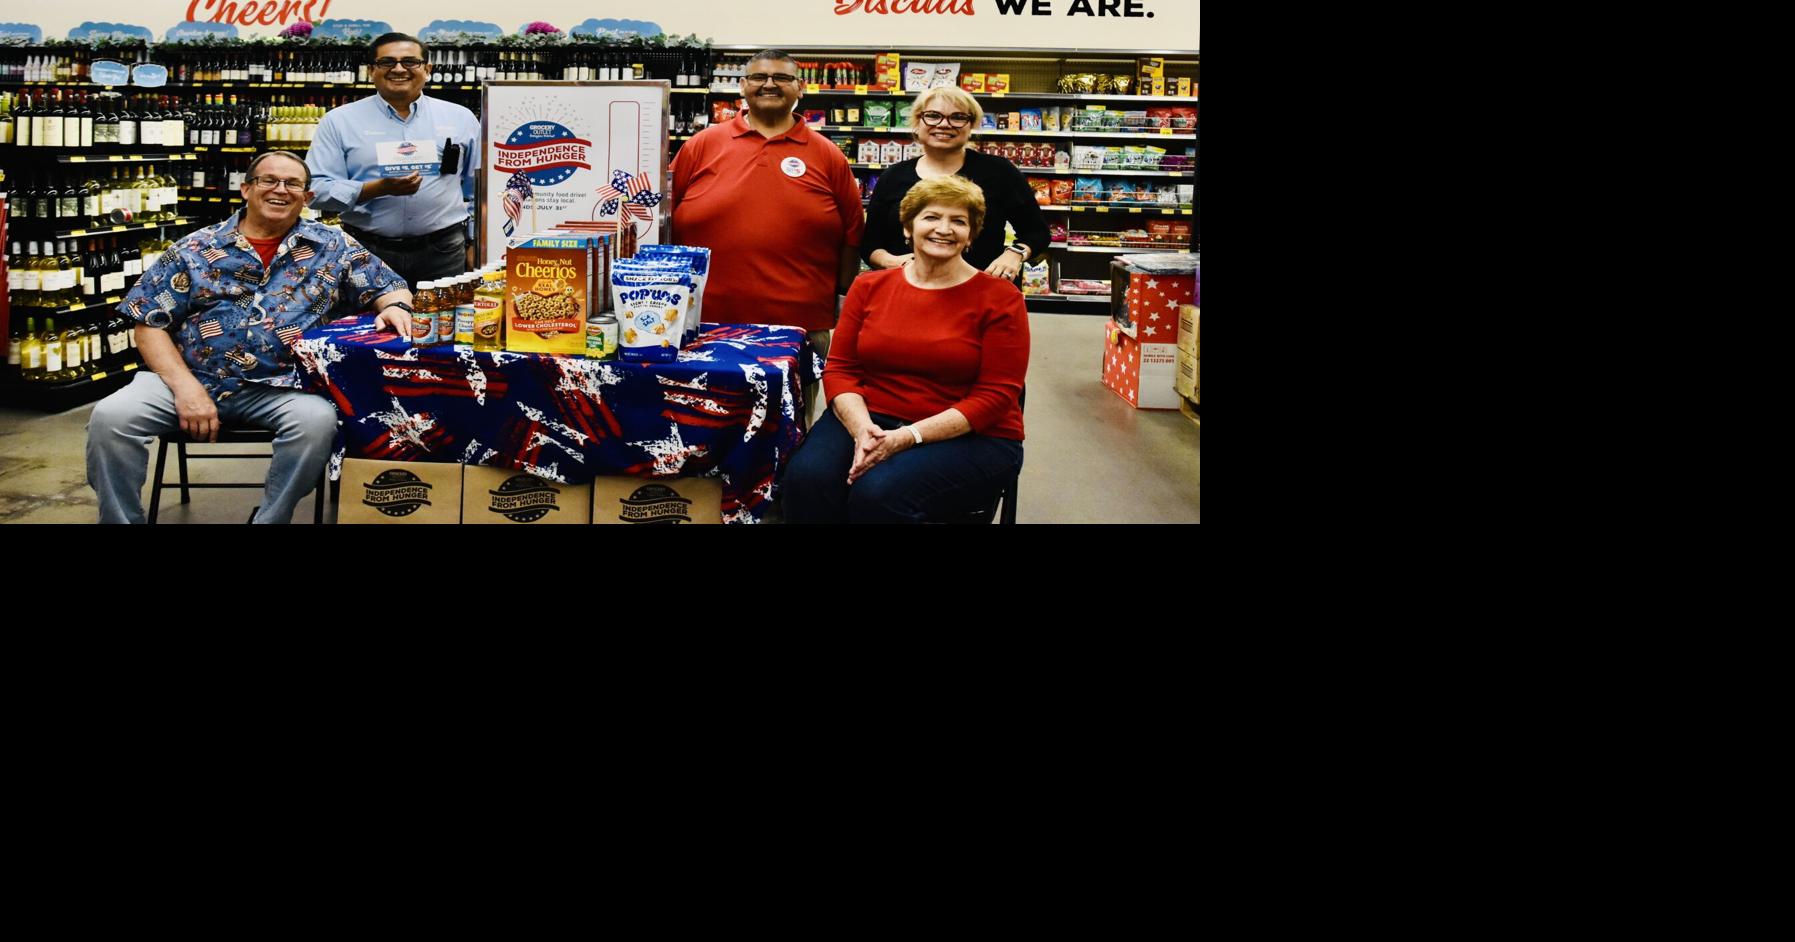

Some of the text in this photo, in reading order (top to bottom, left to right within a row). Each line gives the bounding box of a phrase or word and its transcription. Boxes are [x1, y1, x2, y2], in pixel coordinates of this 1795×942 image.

[995, 0, 1052, 16] WE
[498, 145, 586, 159] INDEPENDENCE
[498, 152, 586, 167] FROM HUNGER
[532, 239, 579, 248] FAMILY SIZE
[537, 258, 557, 266] Honey
[515, 262, 577, 279] Cheerios
[365, 487, 428, 497] INDEPENDENCE
[365, 492, 428, 502] FROM HUNGER
[492, 492, 556, 503] INDEPENDENCE
[520, 497, 556, 506] HUNGER
[623, 502, 689, 512] INDEPENDENCE
[622, 507, 688, 518] FROM HUNGER
